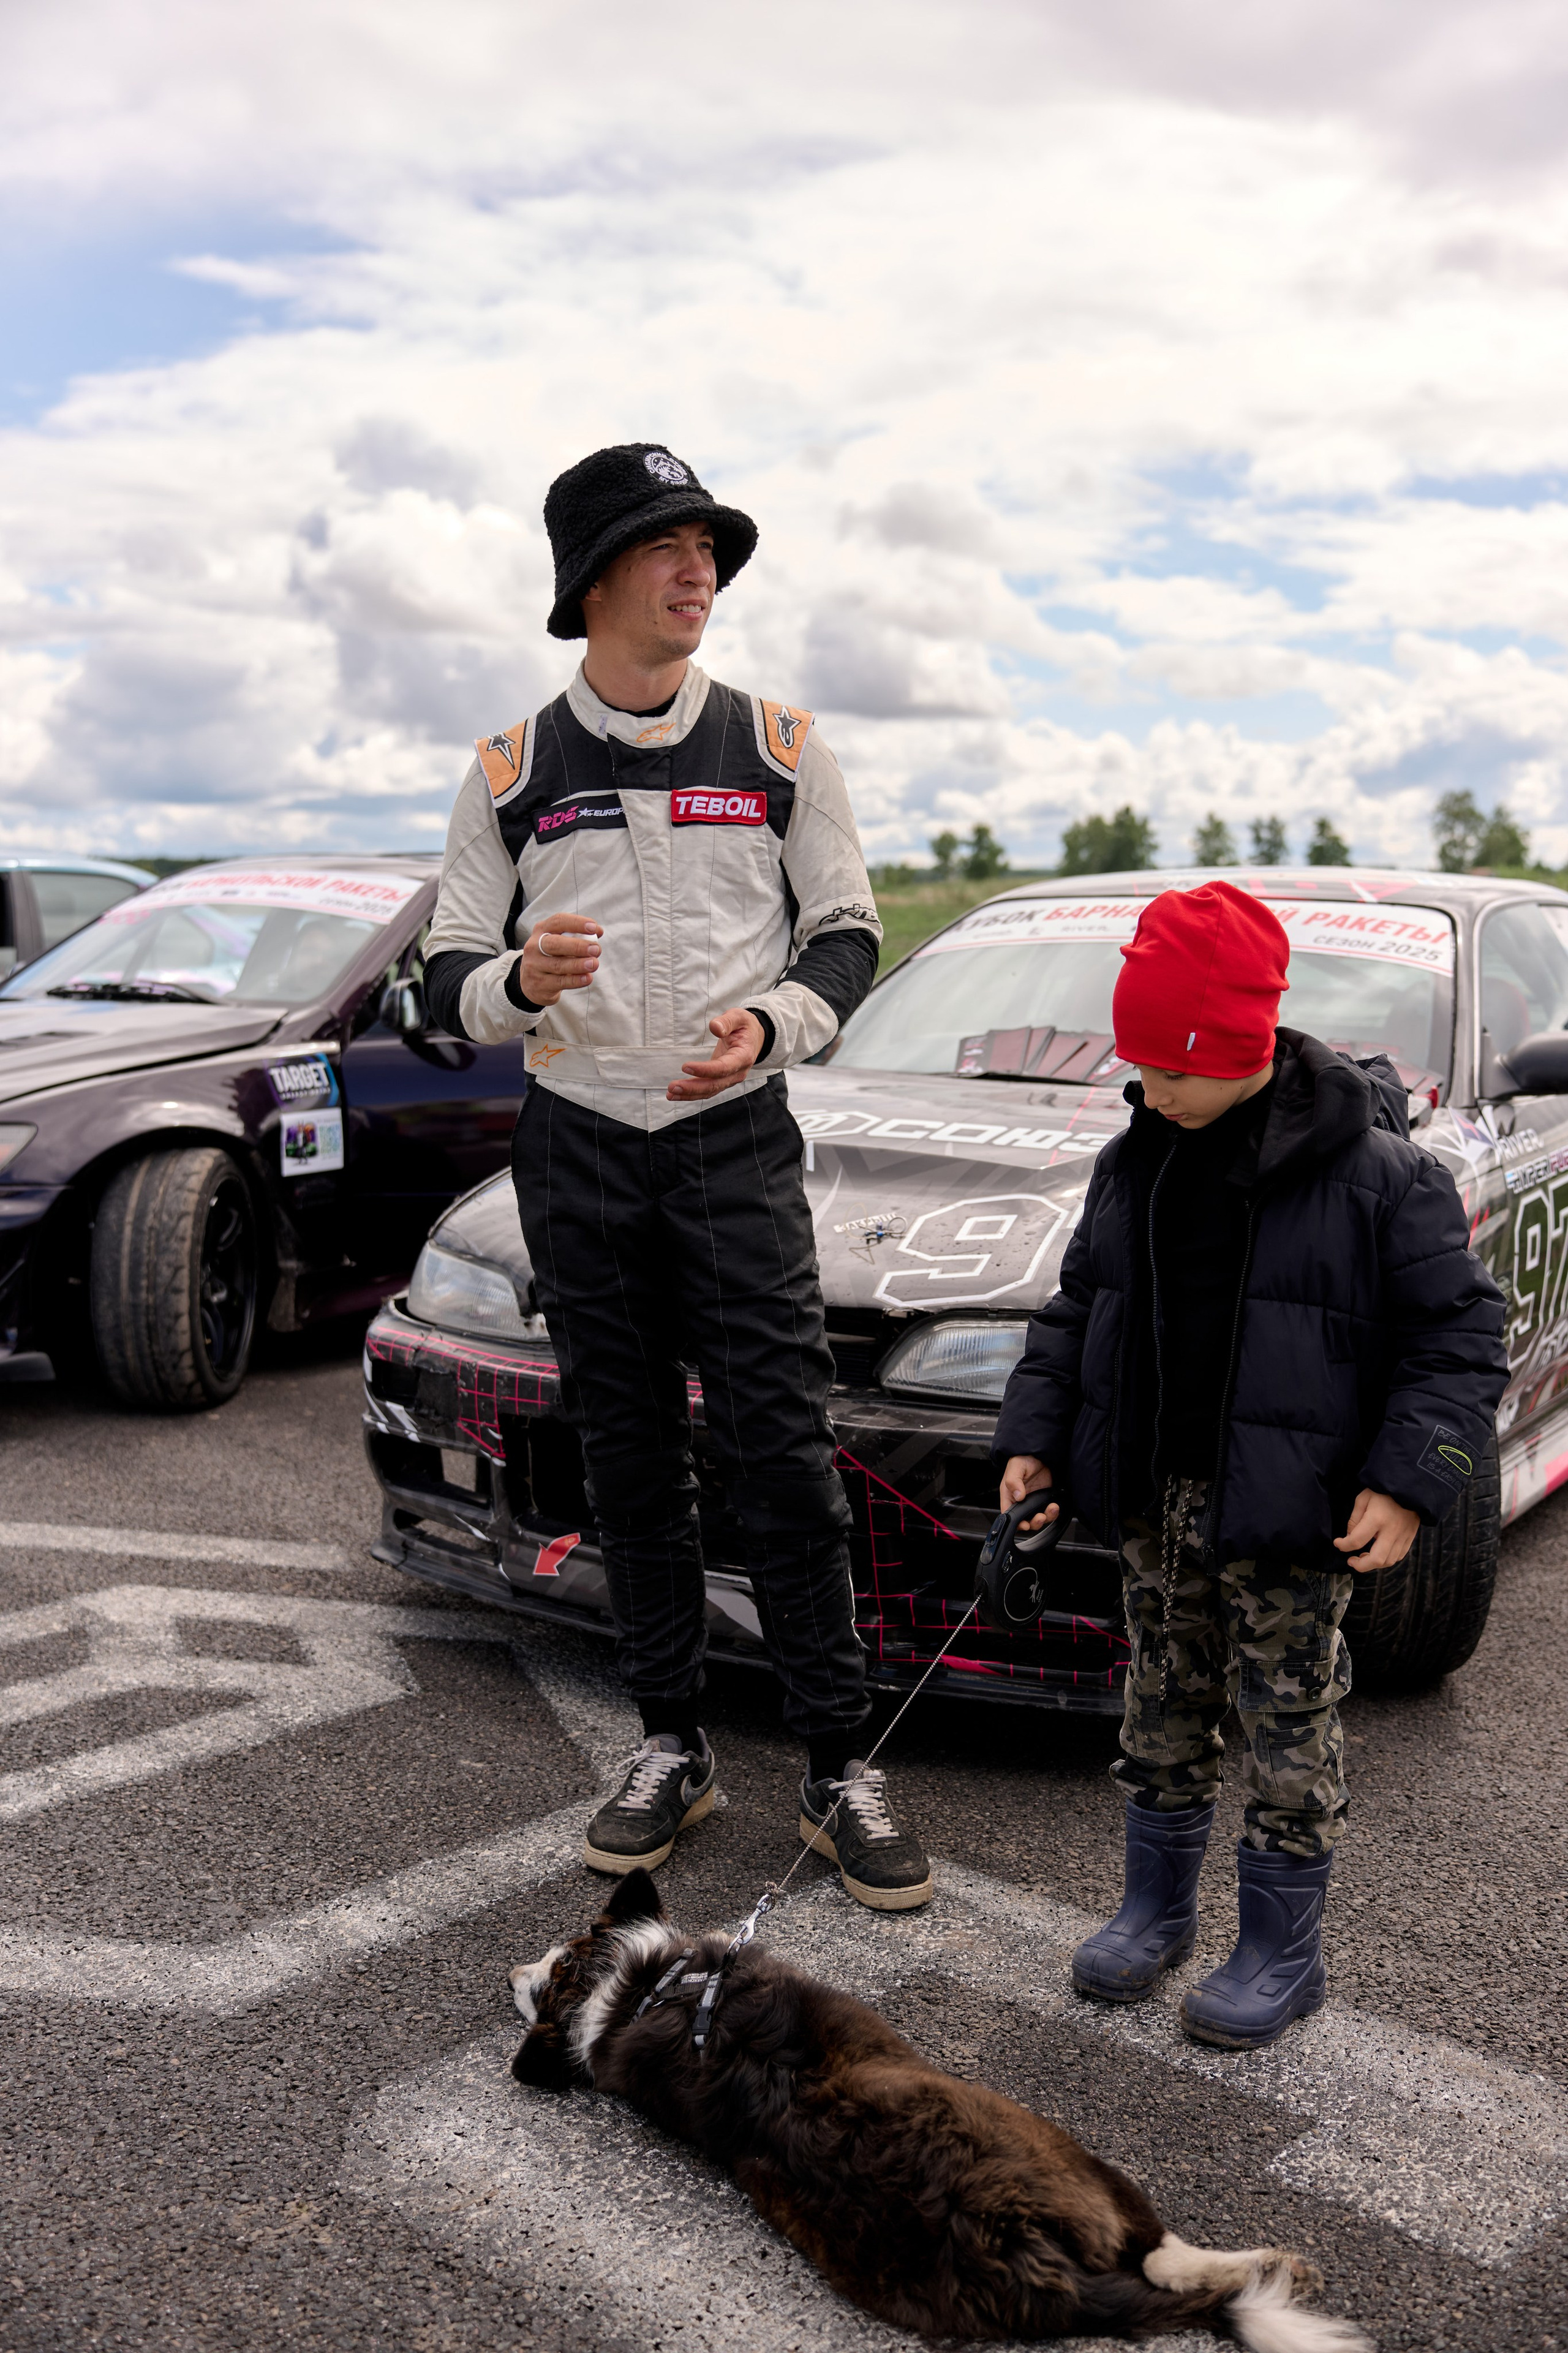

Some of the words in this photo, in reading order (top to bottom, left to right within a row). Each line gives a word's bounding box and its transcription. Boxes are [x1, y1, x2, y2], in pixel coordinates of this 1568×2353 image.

[538, 806, 579, 833] RDS
[593, 807, 625, 817] EUROP
[676, 796, 761, 818] TEBOIL
[1042, 904, 1145, 921] БАРНА
[1302, 912, 1449, 944] РАКЕТЫ
[1313, 935, 1376, 949] СЕЗОН
[1378, 941, 1443, 962] 2025
[268, 1062, 330, 1093] TARGET
[873, 1193, 1084, 1309] 9
[1449, 1437, 1461, 1446] ON
[1428, 1452, 1449, 1468] EVERY
